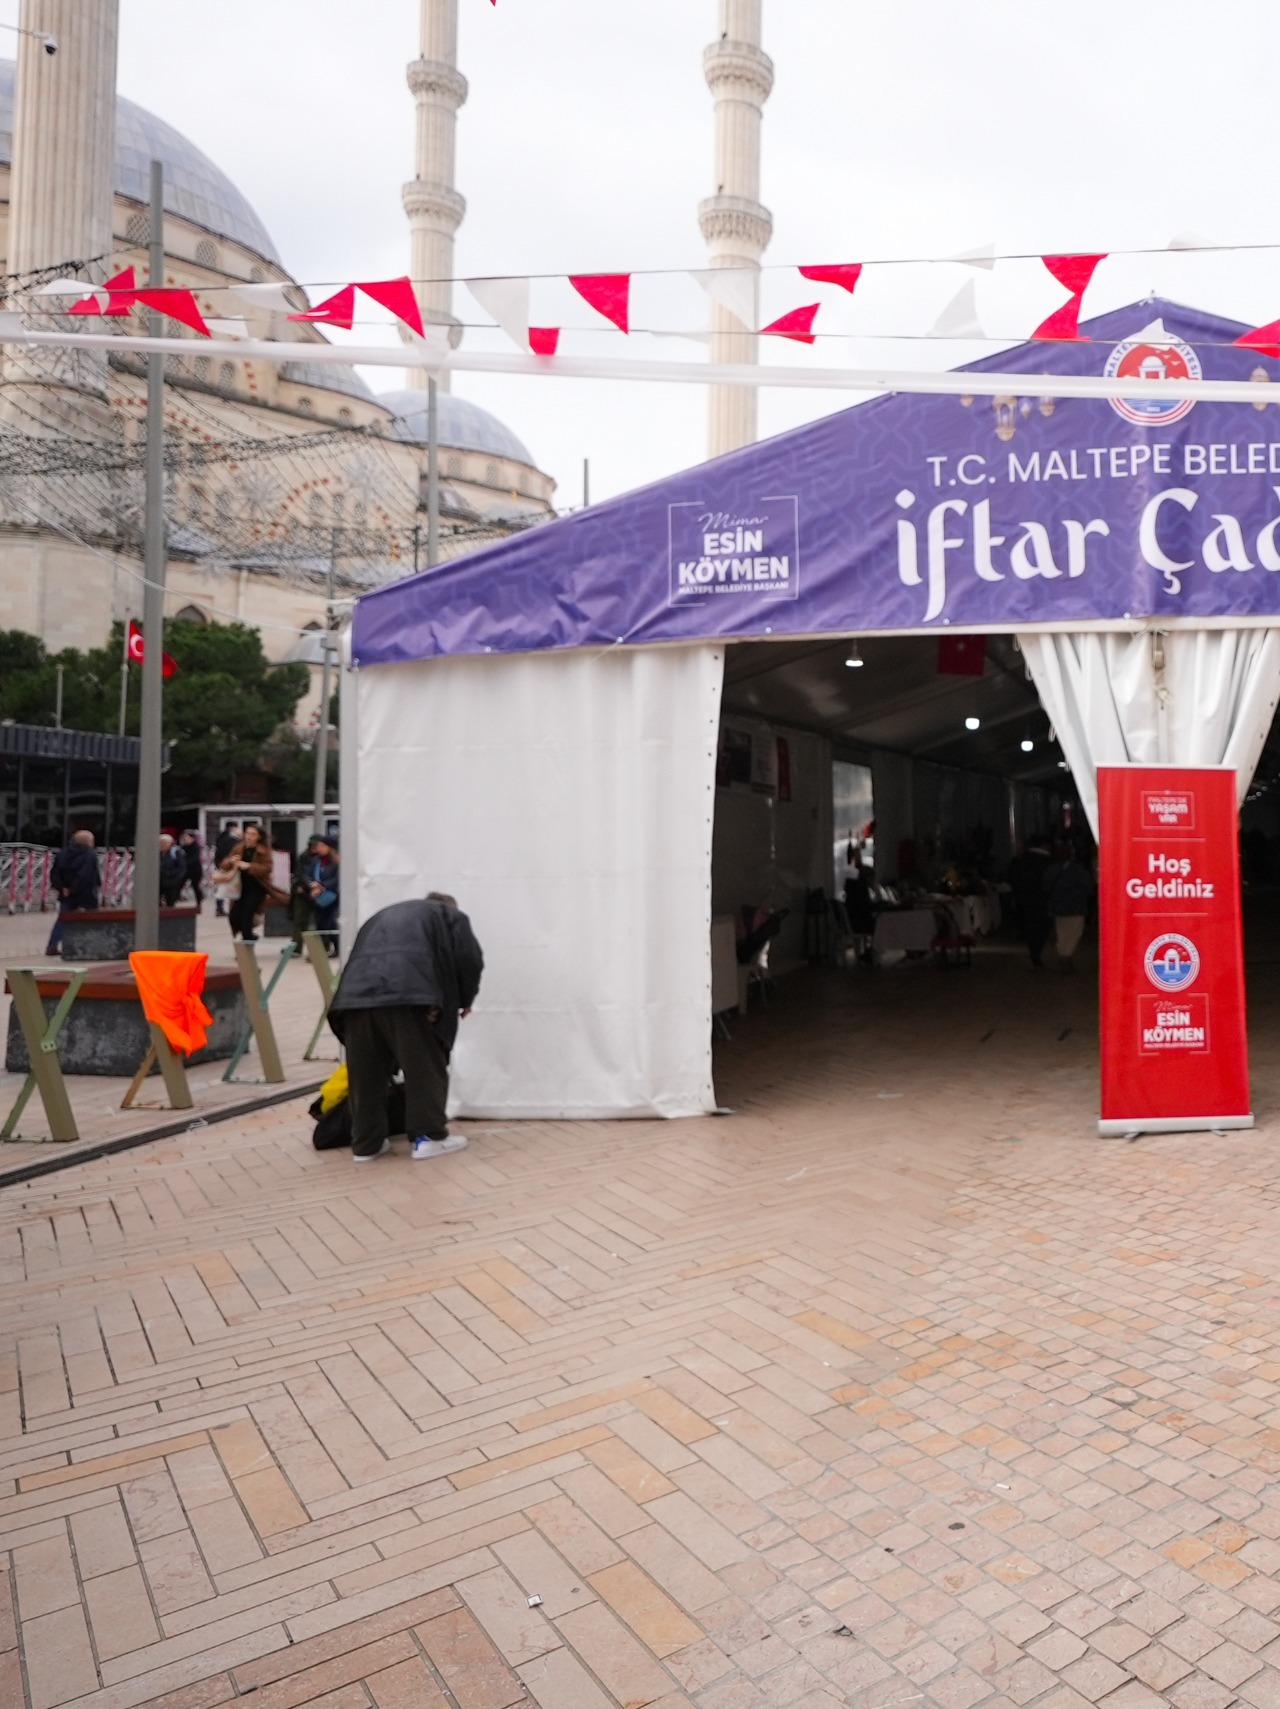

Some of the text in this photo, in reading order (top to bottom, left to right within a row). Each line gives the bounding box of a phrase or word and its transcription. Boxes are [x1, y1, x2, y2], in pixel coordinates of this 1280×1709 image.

[927, 454, 996, 488] T.C.
[1007, 443, 1172, 483] MALTEPE
[697, 511, 769, 532] Mimar
[703, 526, 763, 556] ESİN
[678, 555, 790, 585] KÖYMEN
[1148, 853, 1191, 876] Hoş
[1126, 878, 1214, 898] Geldiniz
[1156, 1009, 1191, 1026] ESİN
[1143, 1025, 1205, 1043] KÖYMEN
